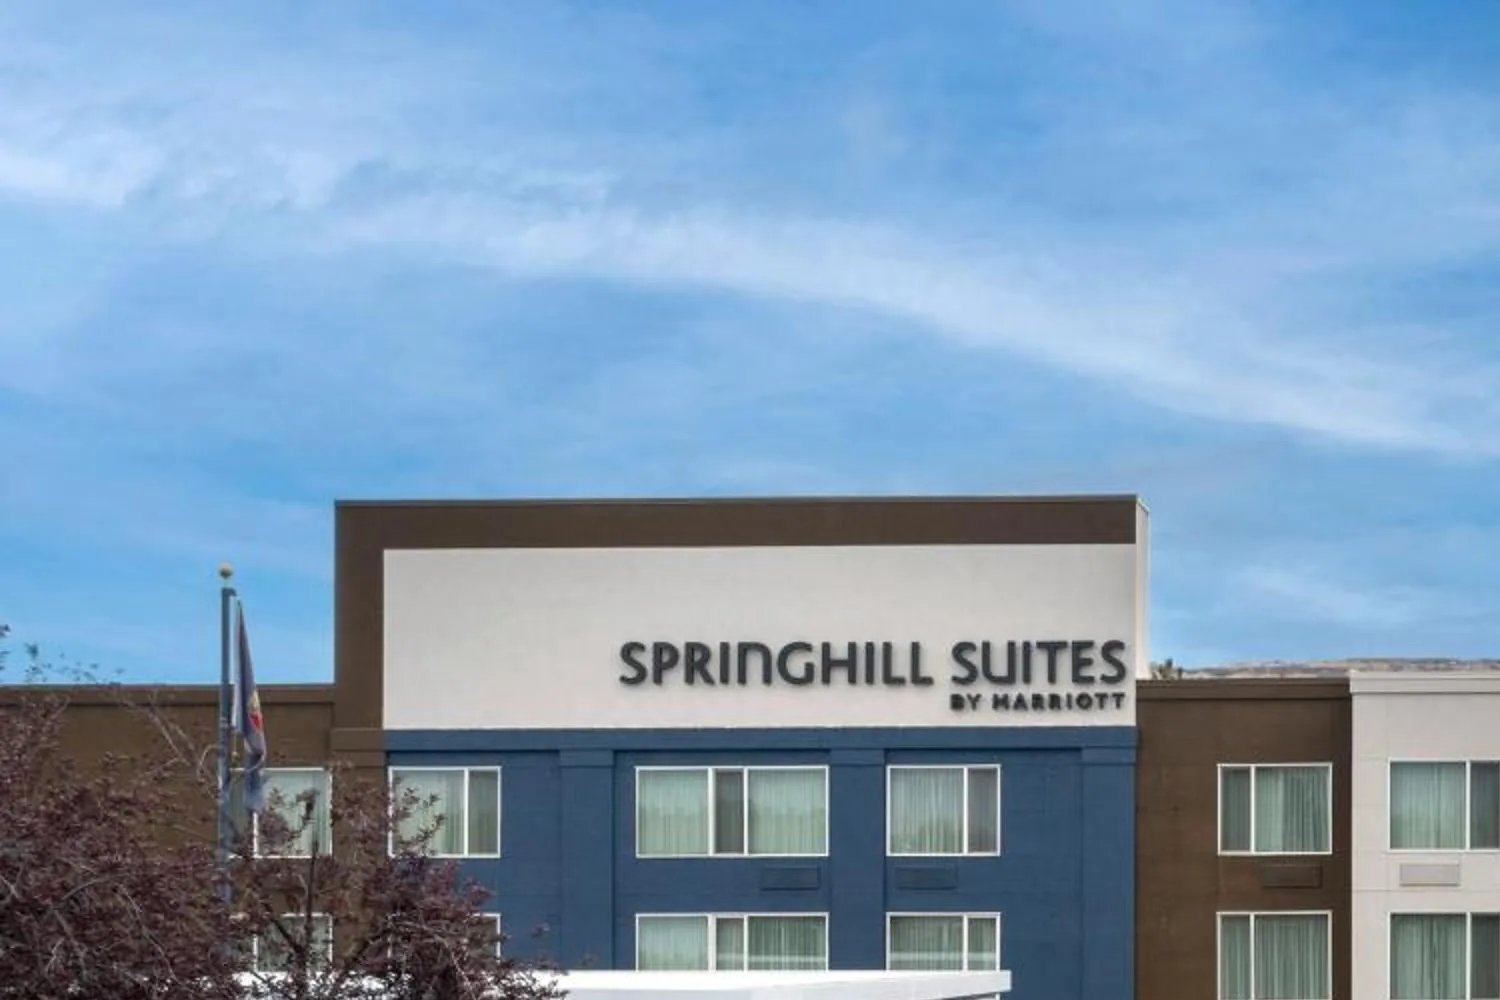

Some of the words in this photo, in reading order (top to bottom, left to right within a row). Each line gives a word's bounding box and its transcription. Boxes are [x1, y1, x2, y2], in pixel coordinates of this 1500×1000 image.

[618, 641, 935, 688] SPRINGHILL
[950, 640, 1128, 688] SUITES
[950, 693, 982, 711] BY
